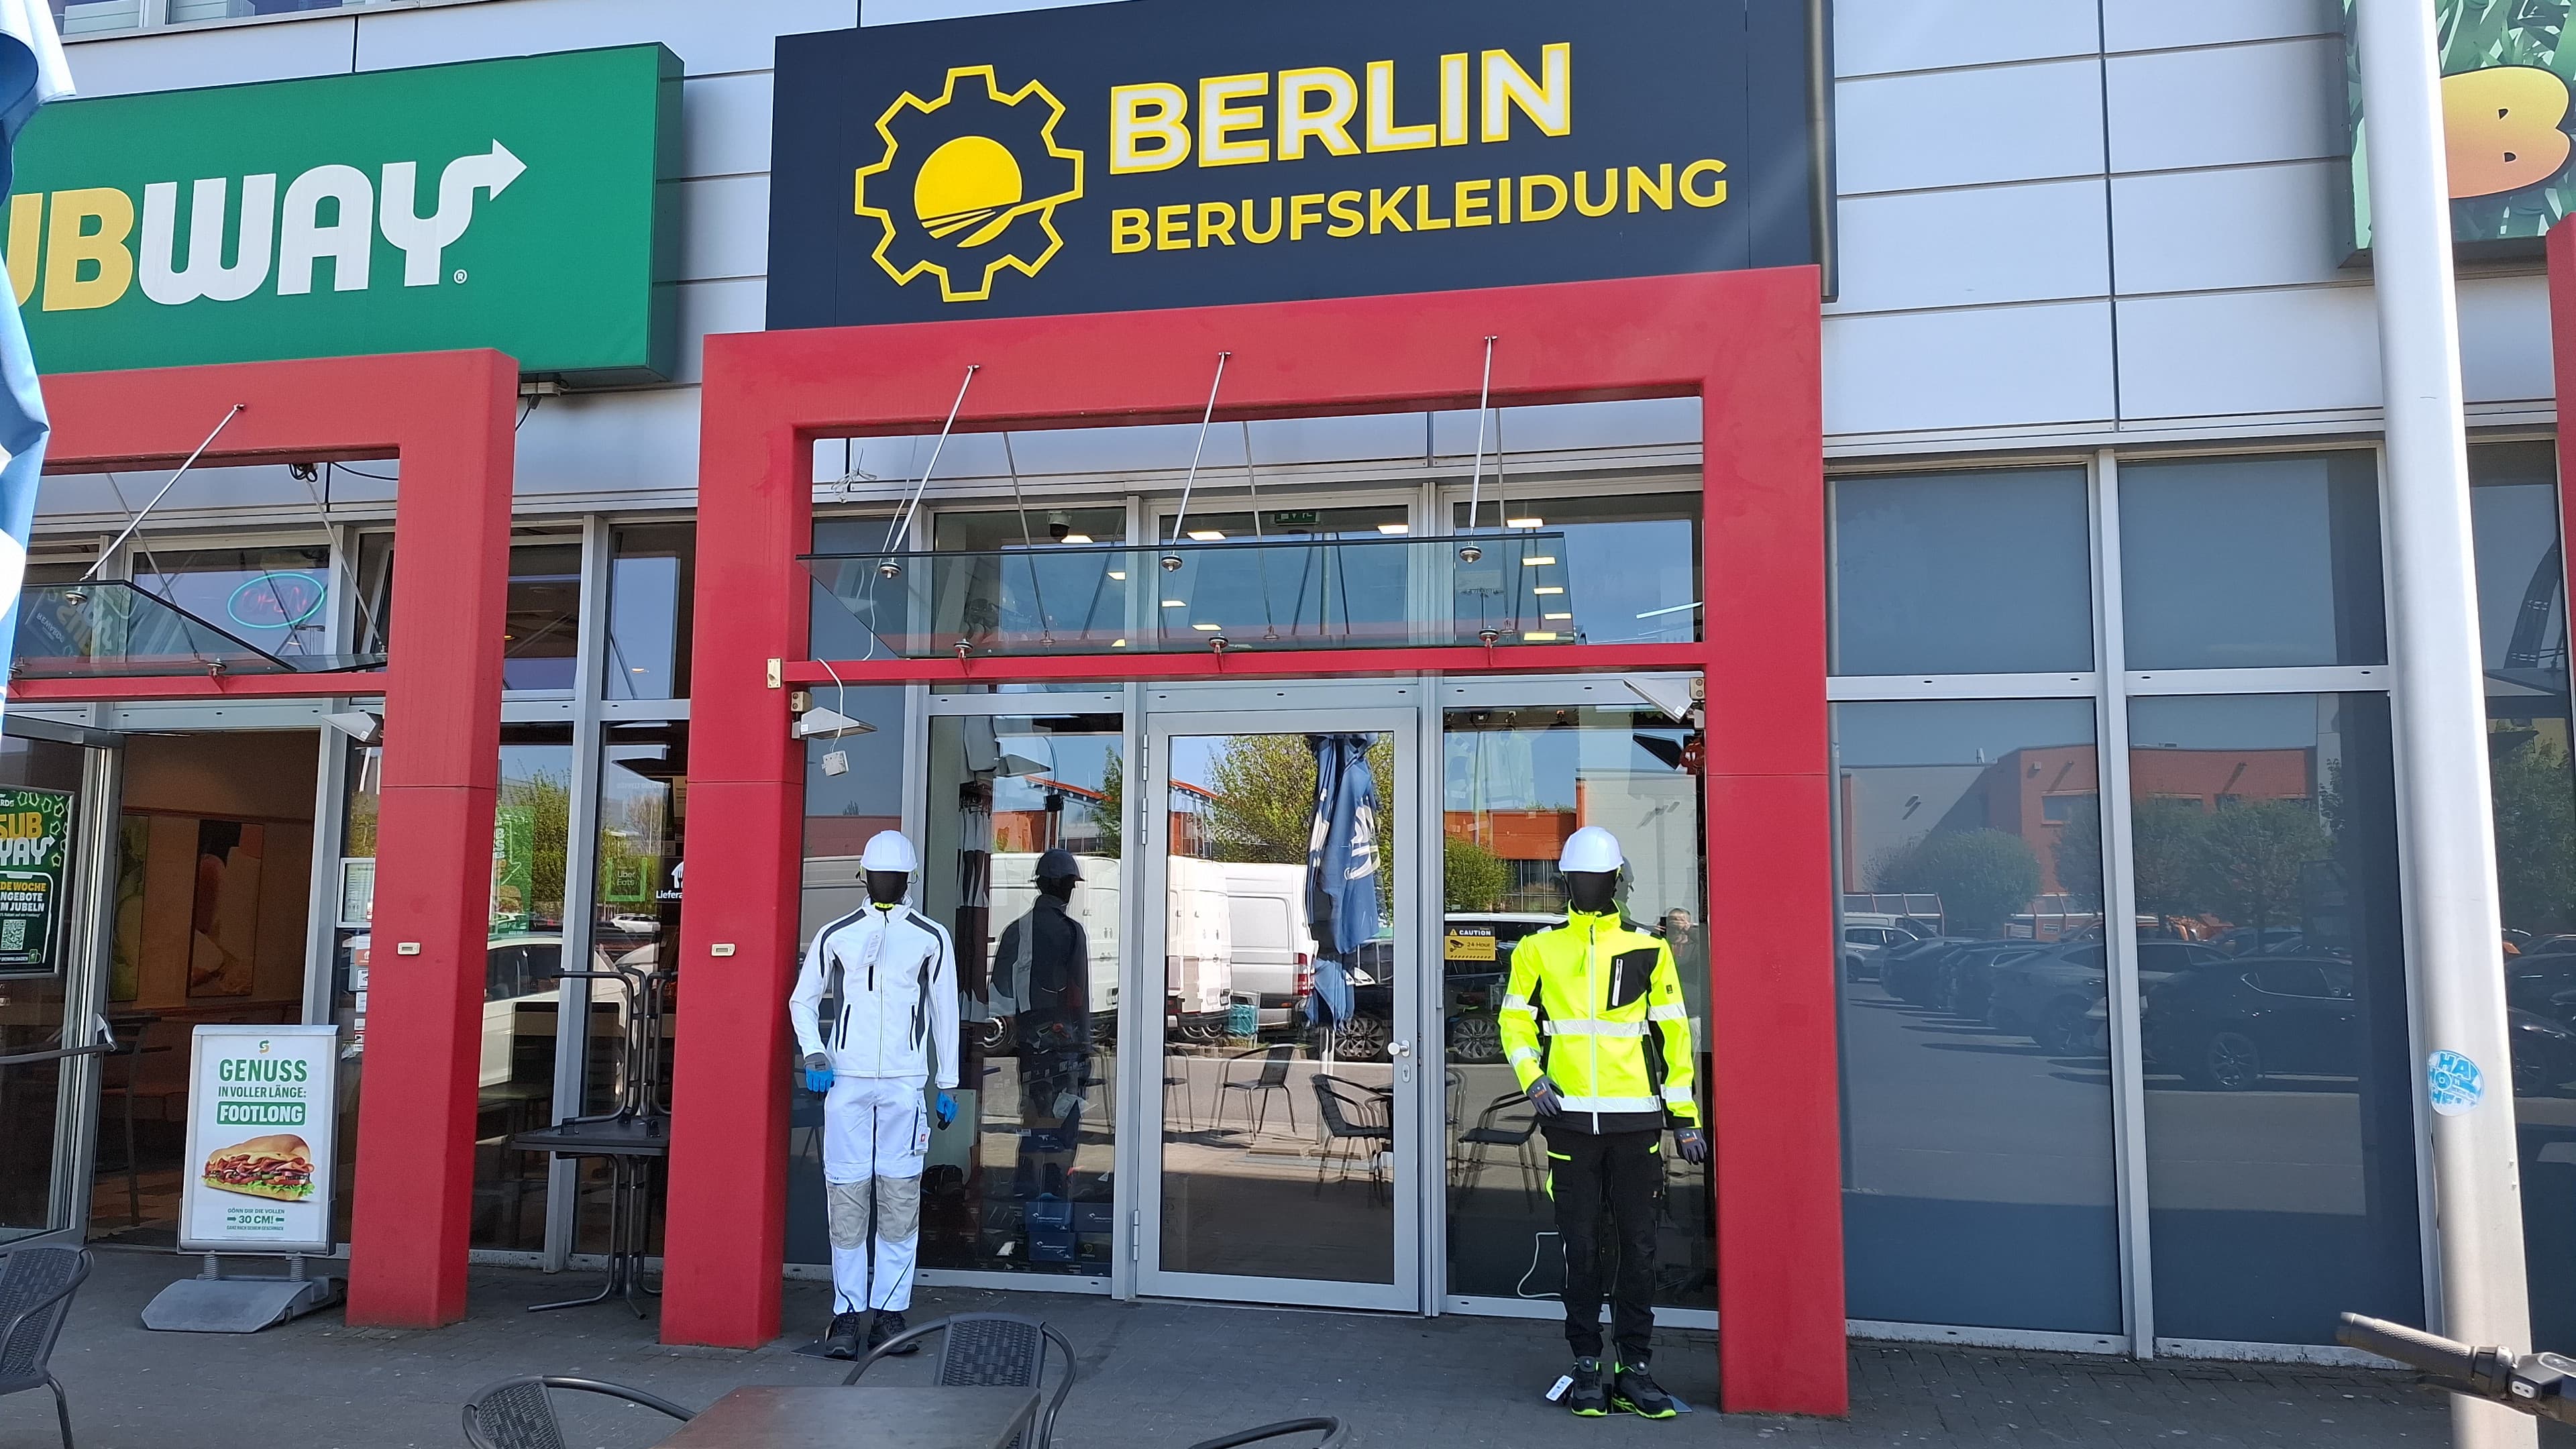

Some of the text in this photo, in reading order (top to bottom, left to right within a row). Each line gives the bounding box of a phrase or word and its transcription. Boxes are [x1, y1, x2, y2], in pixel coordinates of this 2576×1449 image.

[1109, 42, 1571, 175] BERLIN
[2440, 65, 2571, 199] B
[1110, 158, 1728, 254] BERUFSKLEIDUNG
[5, 138, 528, 313] UBWAY
[0, 799, 14, 807] RDS
[617, 870, 637, 878] Uber
[0, 881, 46, 892] DE WOCHE
[617, 878, 635, 886] Eats
[0, 892, 44, 902] NGEBOTE
[656, 890, 683, 899] Liefera
[10, 902, 44, 912] JUBELN
[219, 1059, 308, 1083] GENUSS
[218, 1084, 307, 1098] IN VOLLER LÄNGE:
[219, 1104, 304, 1123] FOOTLONG
[238, 1215, 274, 1224] 30 CM!
